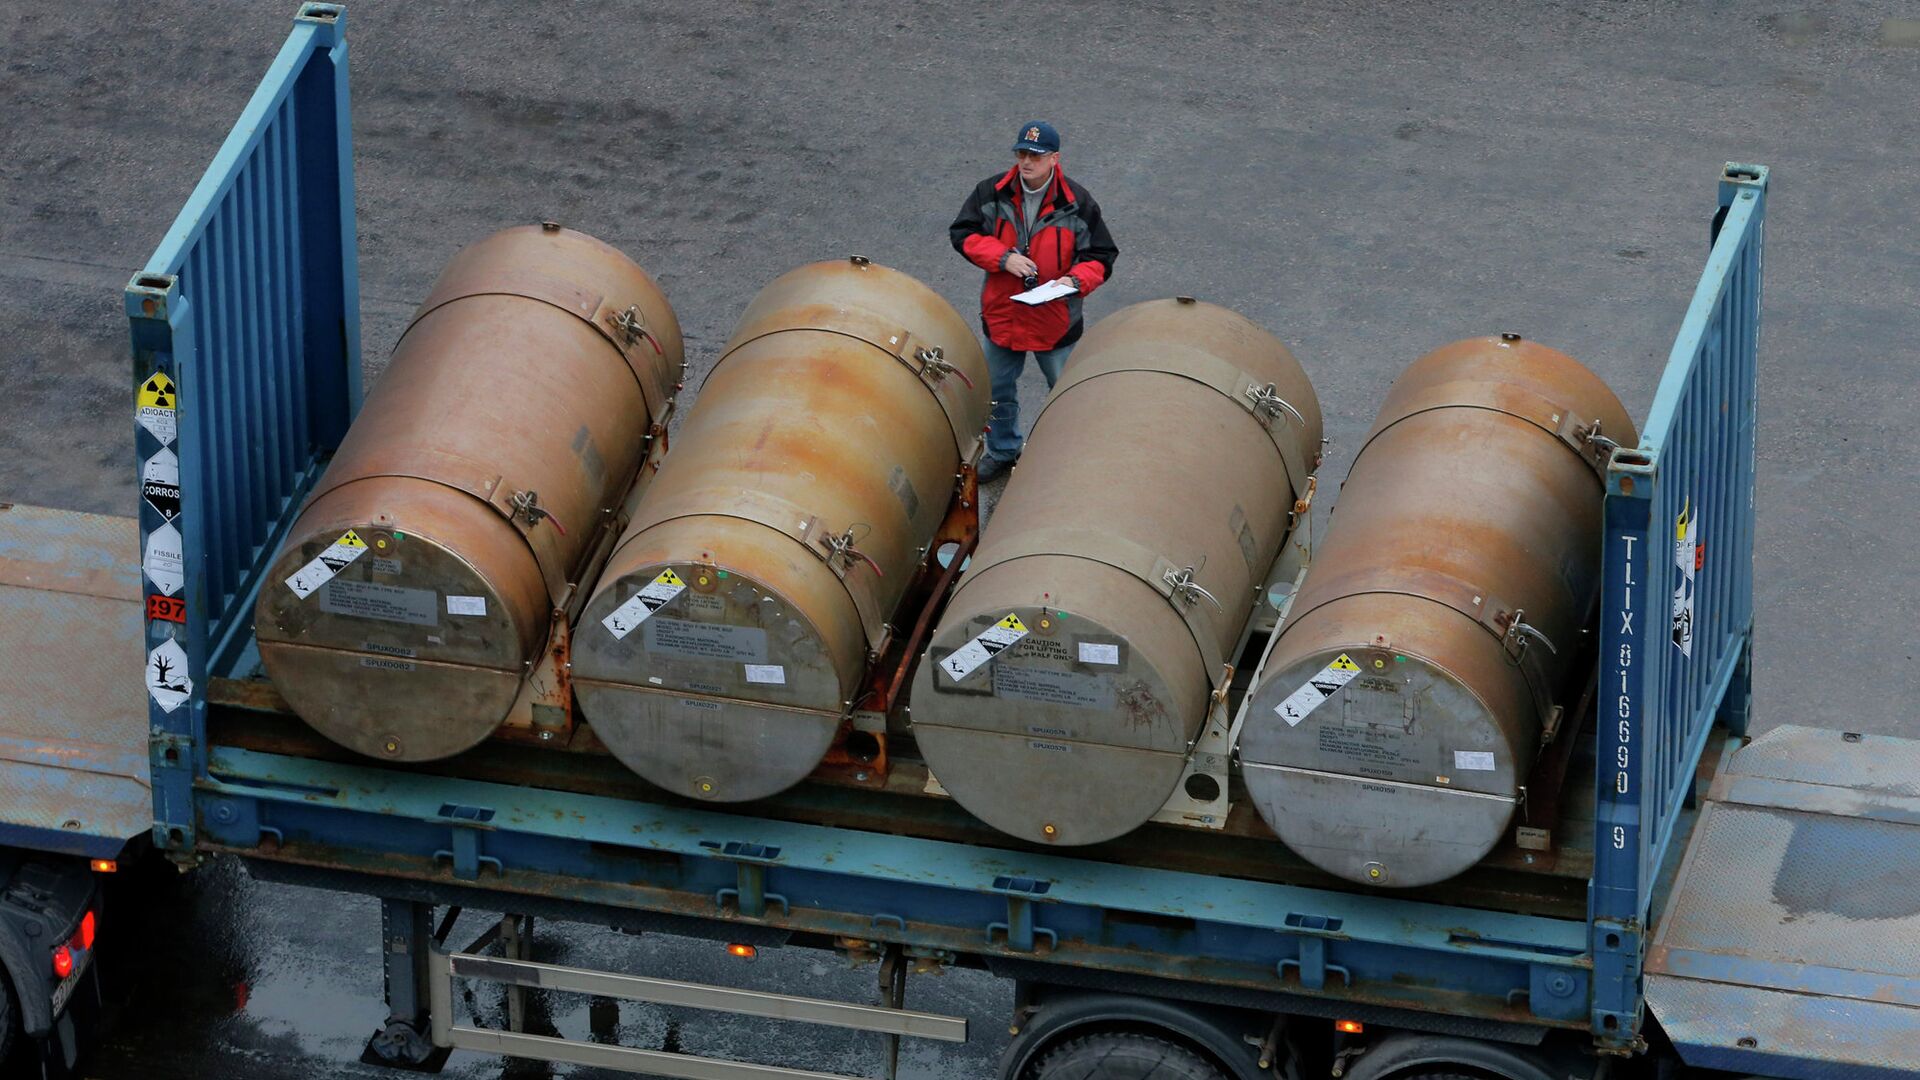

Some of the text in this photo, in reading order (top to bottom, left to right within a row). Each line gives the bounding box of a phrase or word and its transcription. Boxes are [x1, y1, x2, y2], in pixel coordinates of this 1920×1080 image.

[165, 509, 172, 518] 8
[153, 549, 182, 560] FISSILE
[164, 583, 171, 591] 7
[1025, 638, 1061, 647] CAUTION
[1036, 646, 1068, 655] LIFTING
[1612, 826, 1625, 850] 9
